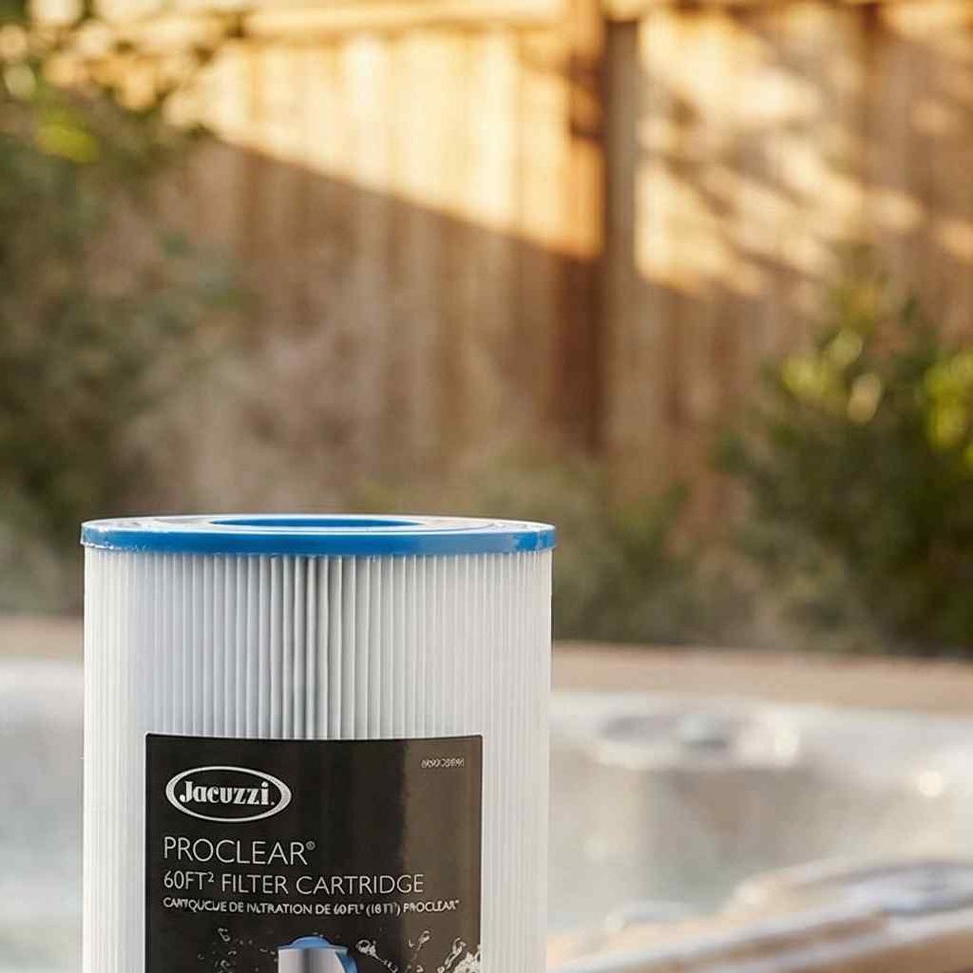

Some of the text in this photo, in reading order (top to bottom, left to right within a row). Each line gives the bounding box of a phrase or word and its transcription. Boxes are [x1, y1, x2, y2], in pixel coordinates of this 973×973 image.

[221, 873, 289, 895] FILTER
[296, 873, 425, 895] CARTRIDGE
[229, 901, 244, 912] DE
[315, 904, 331, 914] DE
